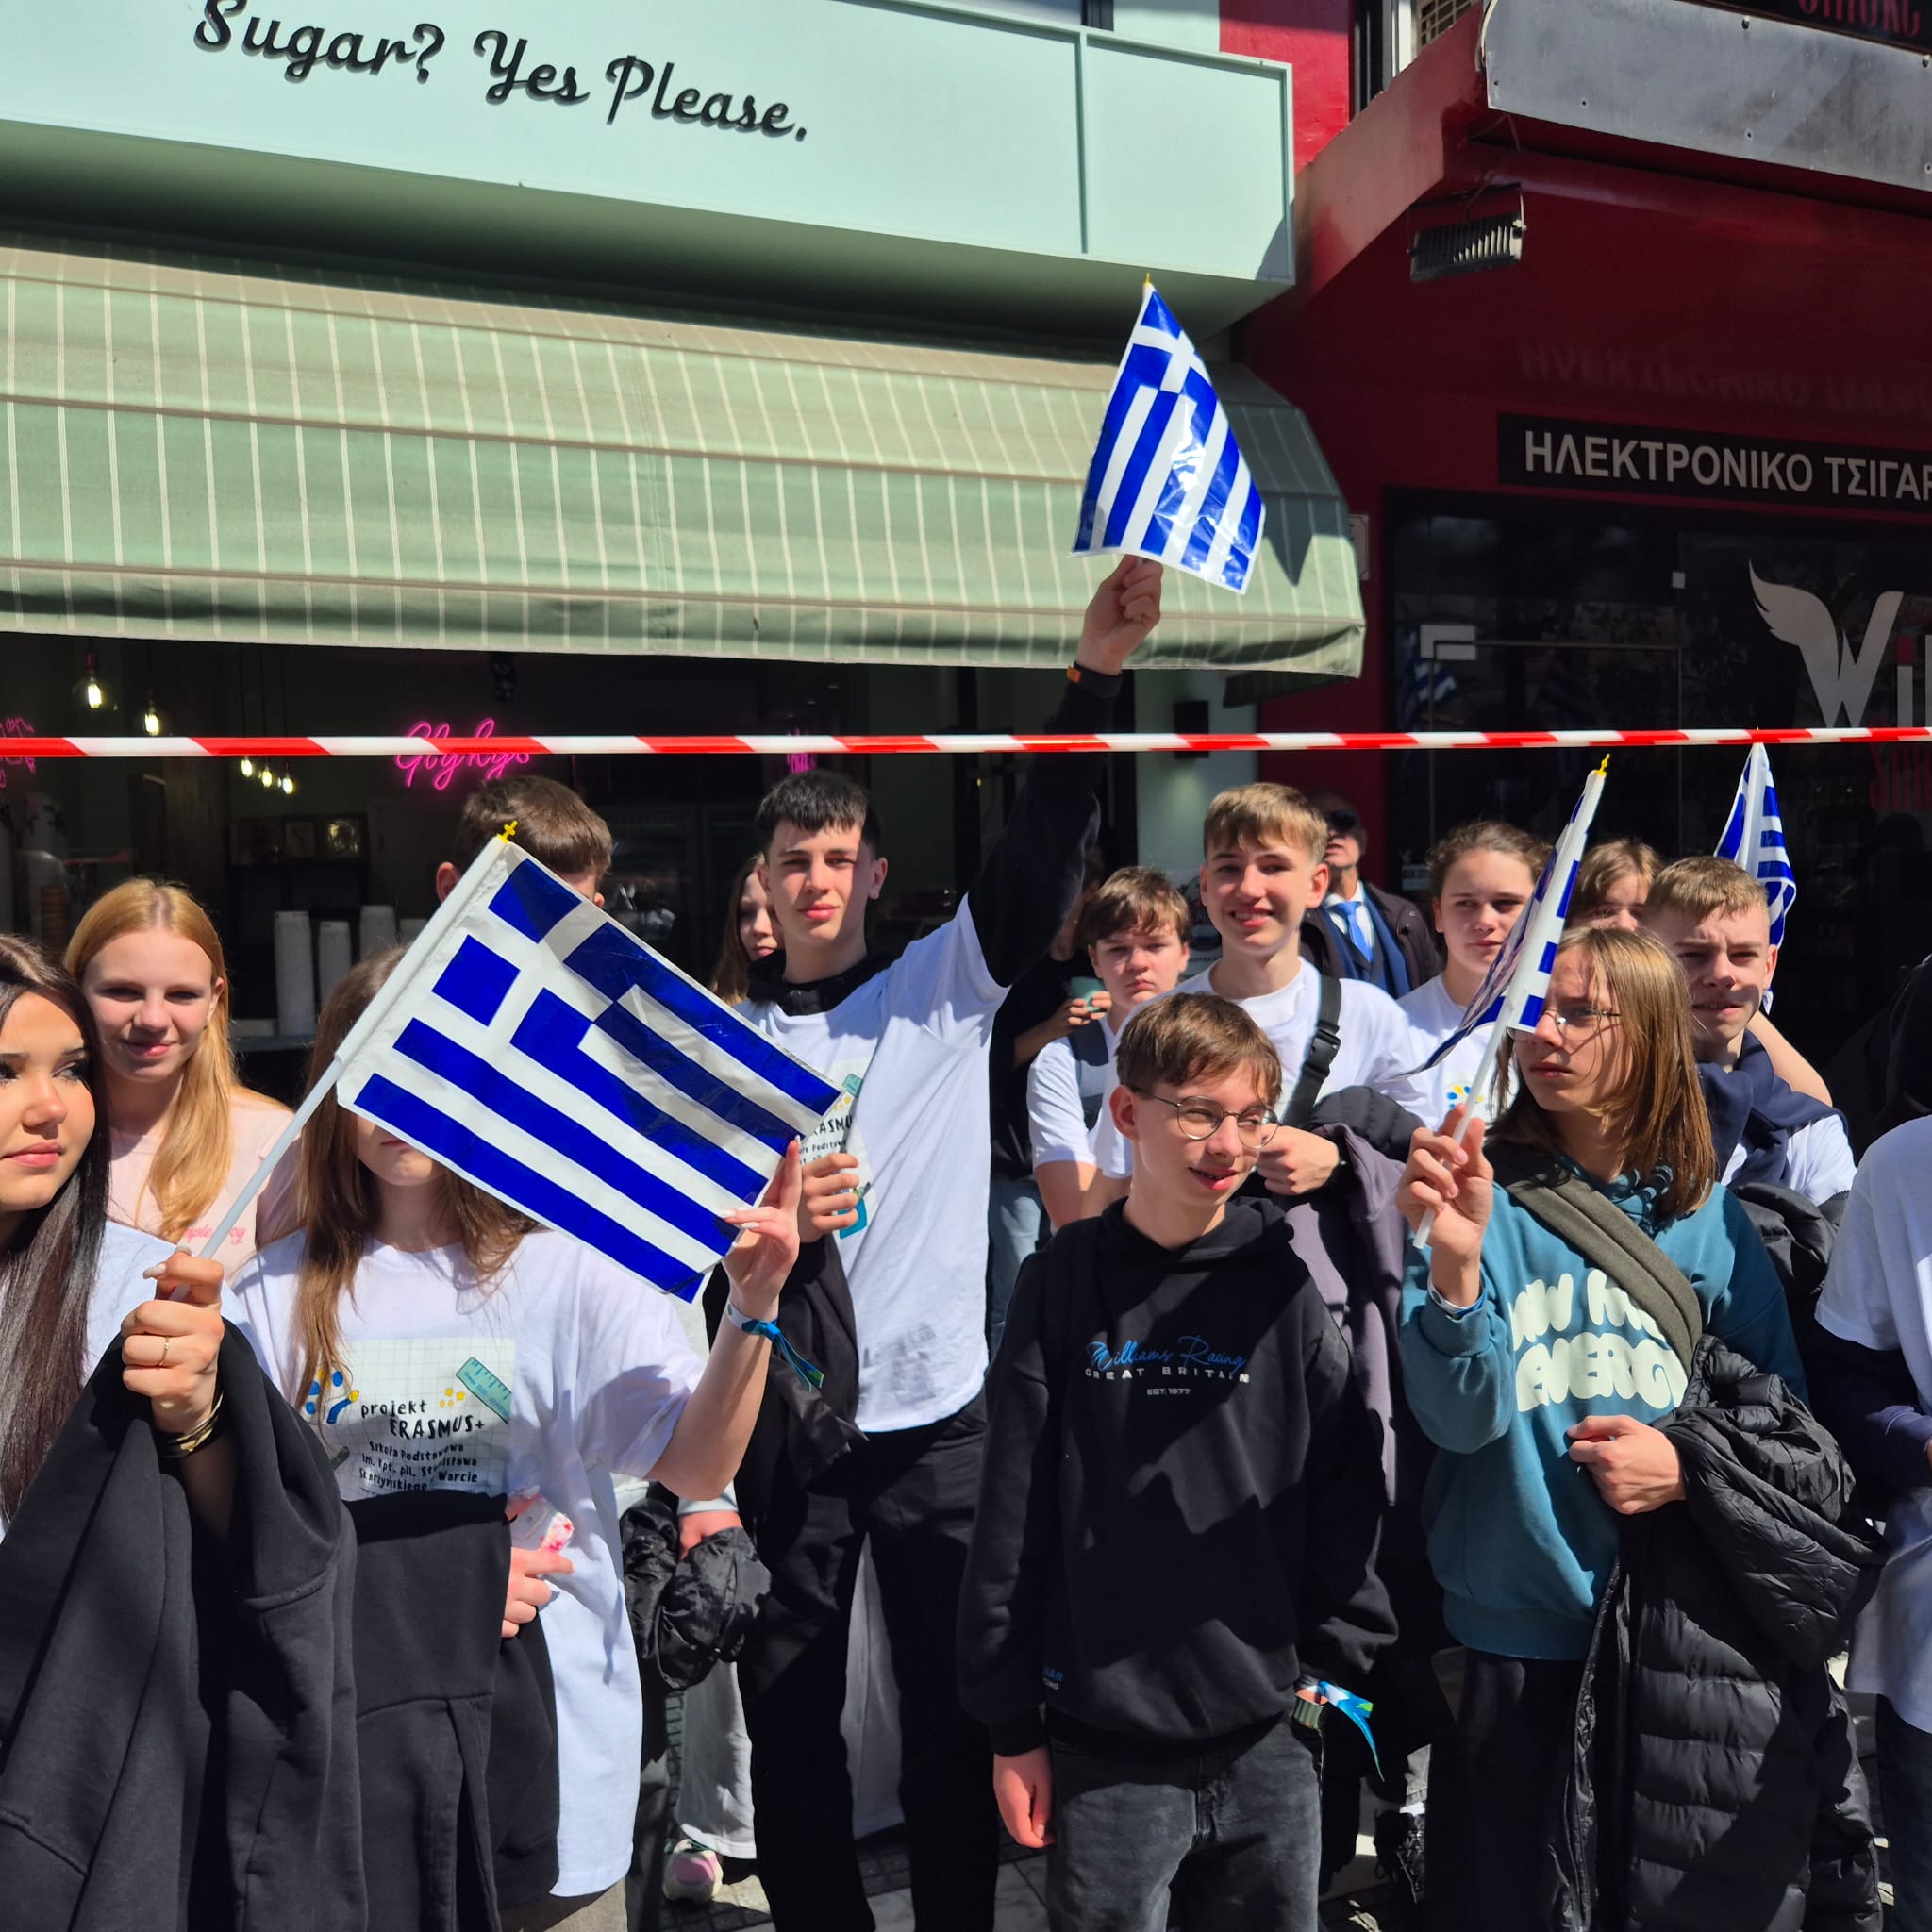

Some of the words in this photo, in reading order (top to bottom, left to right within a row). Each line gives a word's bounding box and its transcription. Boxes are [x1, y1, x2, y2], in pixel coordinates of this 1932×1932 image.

[193, 0, 445, 82] Sugar?
[473, 30, 590, 104] Yes
[605, 54, 808, 141] Please.
[1524, 429, 1813, 492] ΗΛΕΚΤΡΟΝΙΚΟ
[1085, 1367, 1145, 1381] GREAT
[360, 1400, 427, 1420] projekt
[390, 1415, 485, 1441] ERASMUS+
